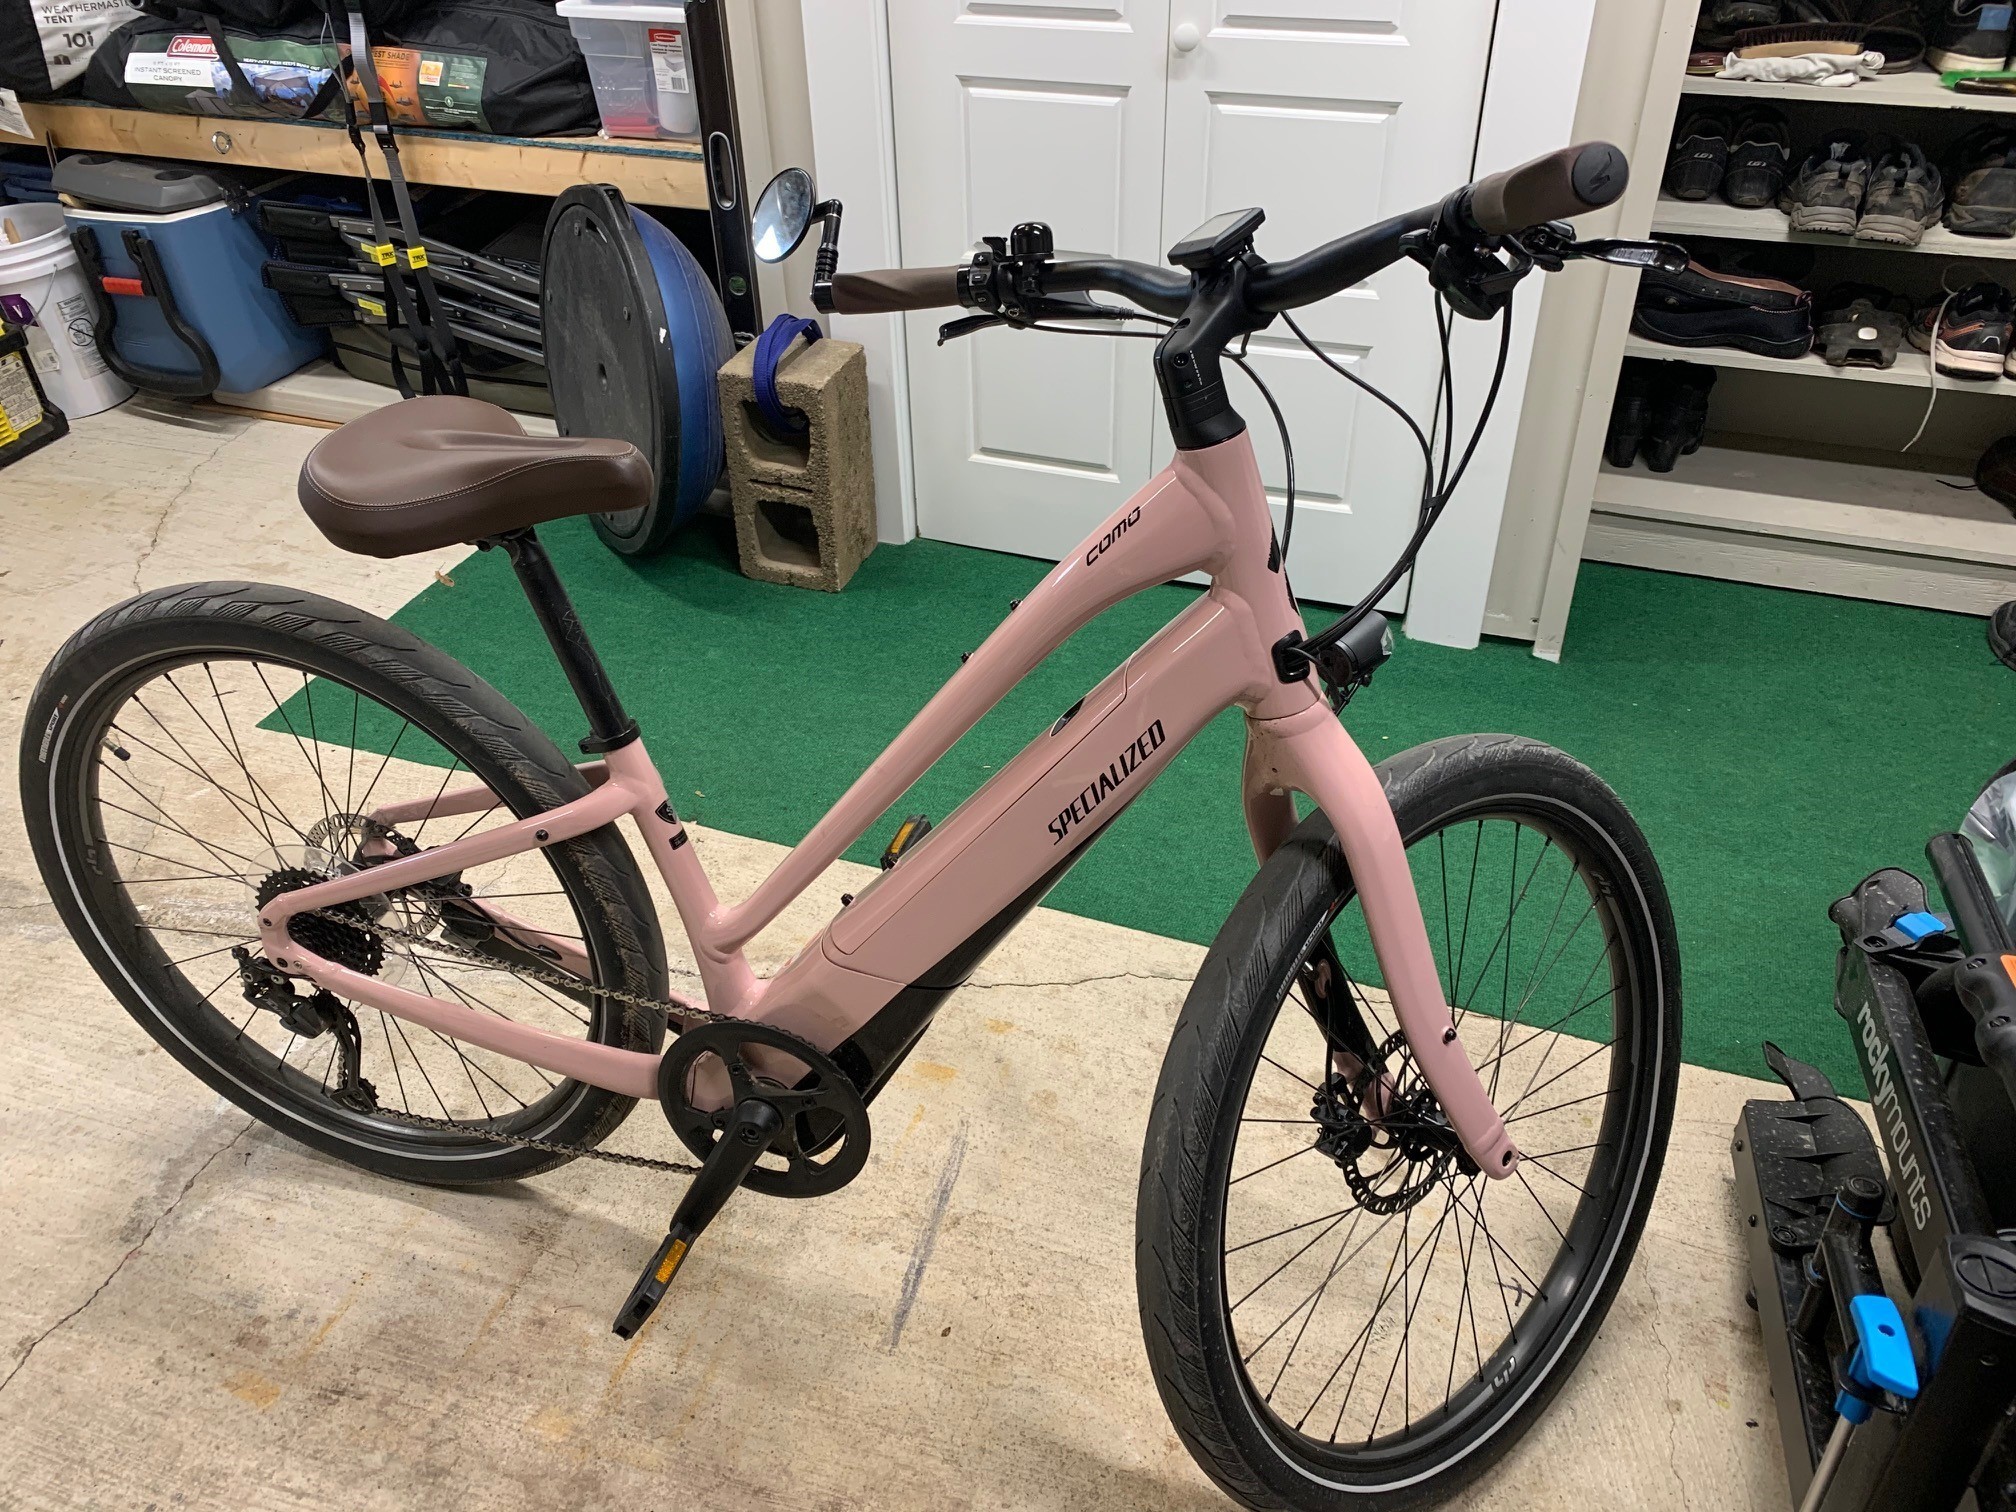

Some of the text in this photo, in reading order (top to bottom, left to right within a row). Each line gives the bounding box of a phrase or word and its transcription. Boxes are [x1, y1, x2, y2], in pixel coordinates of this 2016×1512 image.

[44, 15, 73, 24] TENT
[63, 33, 87, 48] 10
[172, 38, 211, 53] Coleman
[374, 50, 410, 61] EST SHADE
[153, 74, 183, 82] CANOPY
[163, 68, 202, 76] SCREENED
[1047, 719, 1166, 846] SPECIALIZED
[1857, 1001, 1932, 1231] rockymounts
